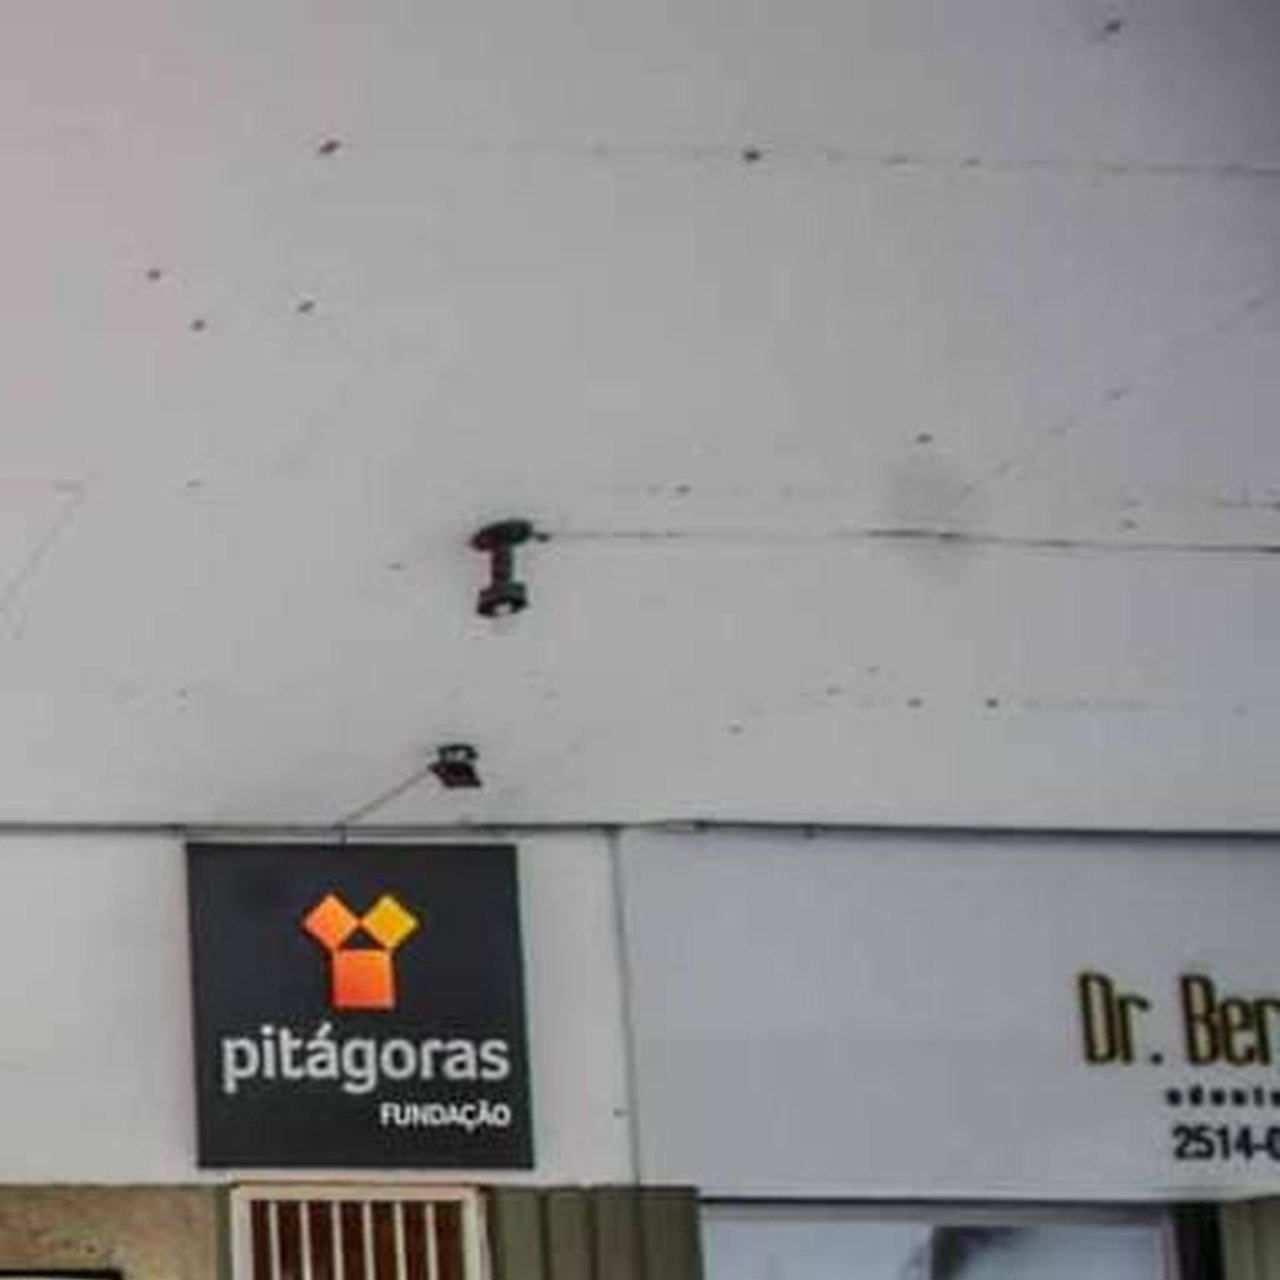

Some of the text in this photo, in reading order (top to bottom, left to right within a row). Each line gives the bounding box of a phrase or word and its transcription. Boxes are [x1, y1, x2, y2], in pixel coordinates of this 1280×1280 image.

[1077, 972, 1280, 1067] Dr. Ber
[221, 1021, 511, 1095] pitágoras
[379, 1099, 513, 1134] FUNDAÇÃO
